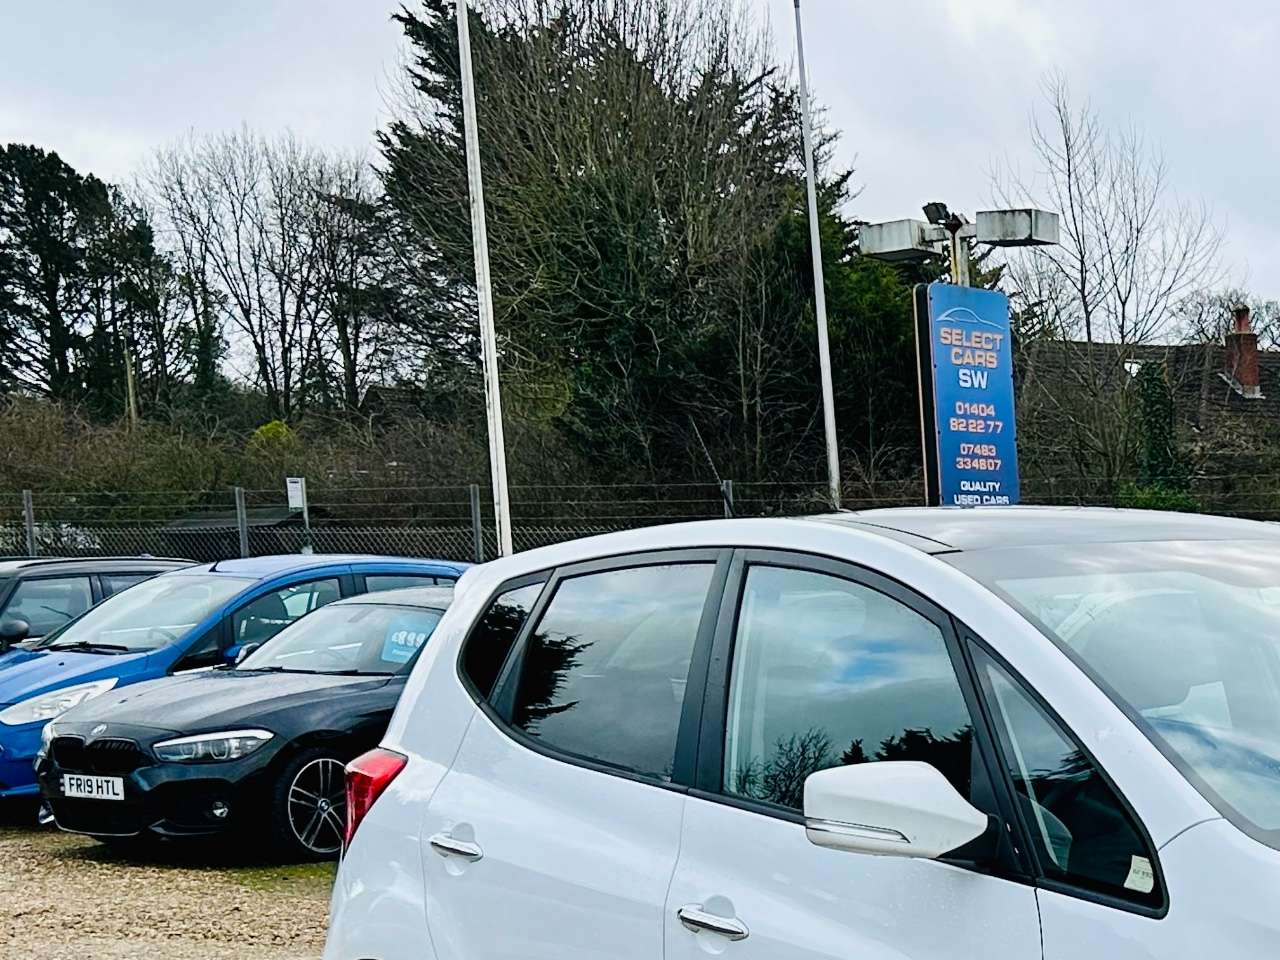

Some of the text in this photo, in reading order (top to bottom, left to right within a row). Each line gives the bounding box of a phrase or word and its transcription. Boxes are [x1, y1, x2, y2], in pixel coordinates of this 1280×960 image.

[940, 327, 1003, 350] SELECT
[951, 348, 998, 368] CARS
[959, 368, 988, 389] SW
[955, 401, 995, 417] 01404
[960, 443, 996, 456] 07483
[960, 480, 1000, 492] QUALITY
[953, 494, 1009, 505] USED CARS
[68, 776, 120, 796] FR19 HTL
